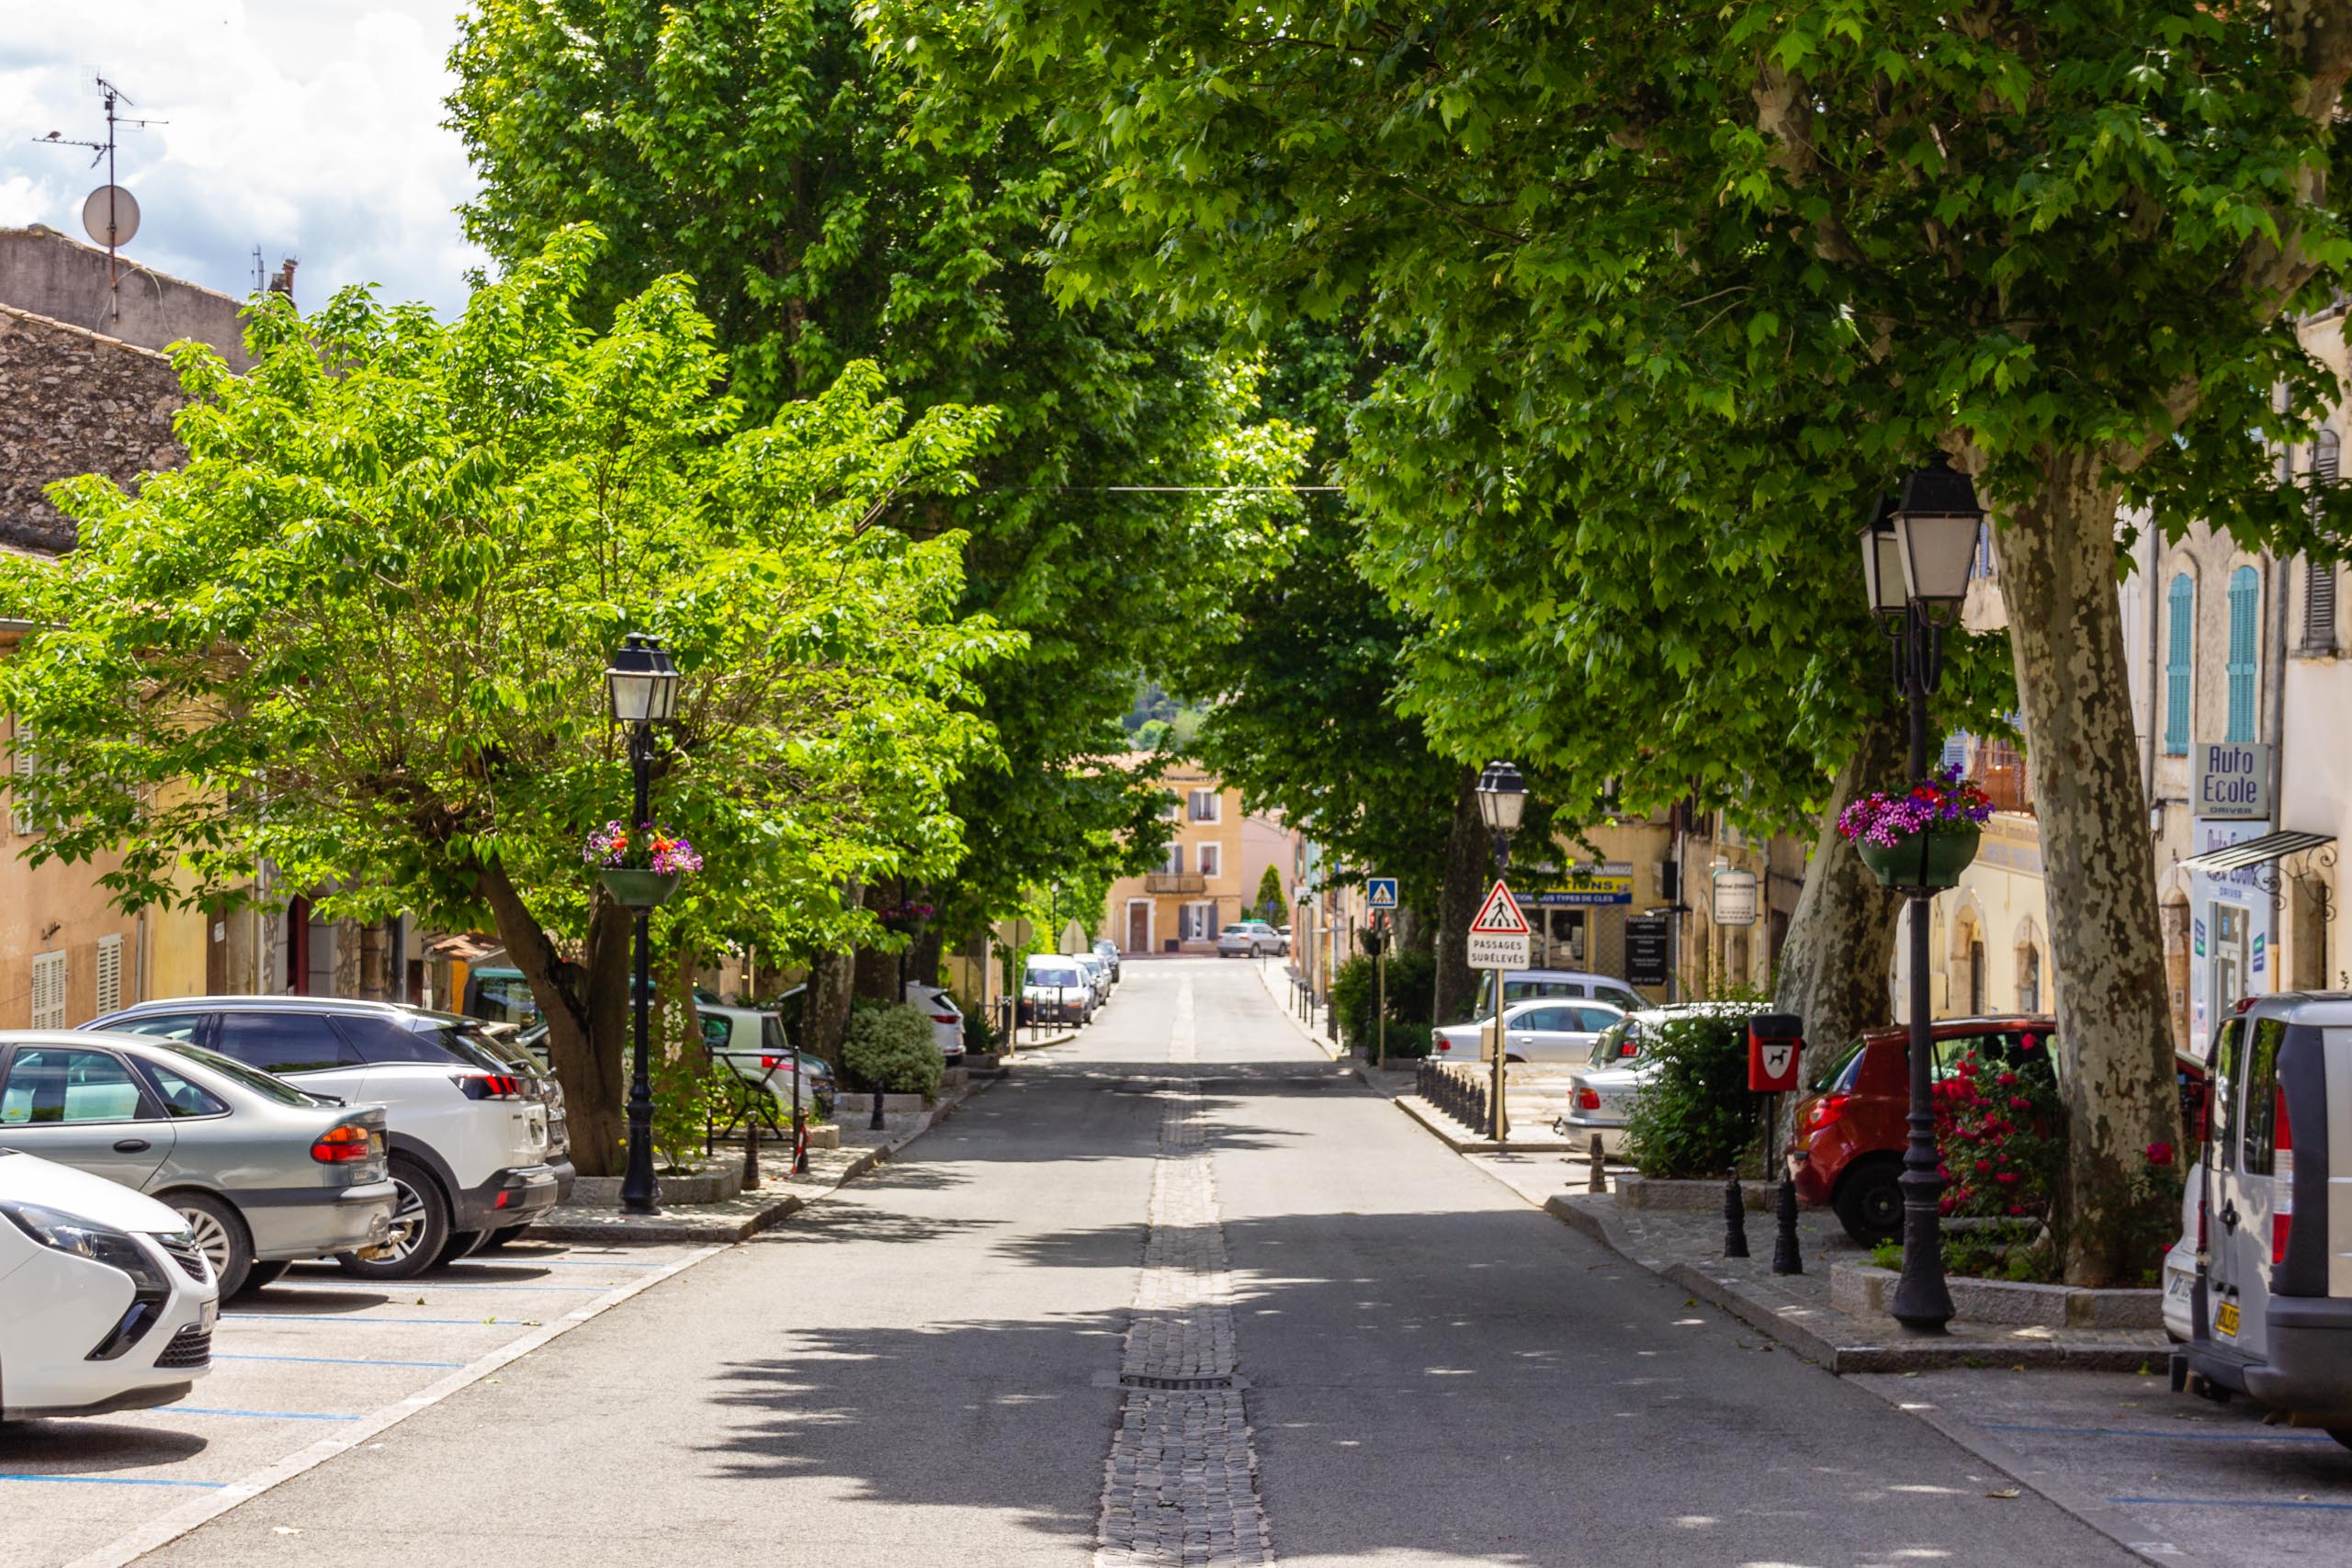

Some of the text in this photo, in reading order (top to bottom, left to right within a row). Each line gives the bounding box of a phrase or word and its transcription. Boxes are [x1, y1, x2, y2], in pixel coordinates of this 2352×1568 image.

[2209, 746, 2254, 774] Auto
[2204, 774, 2257, 804] Ecole
[1473, 940, 1522, 951] PASSAGES
